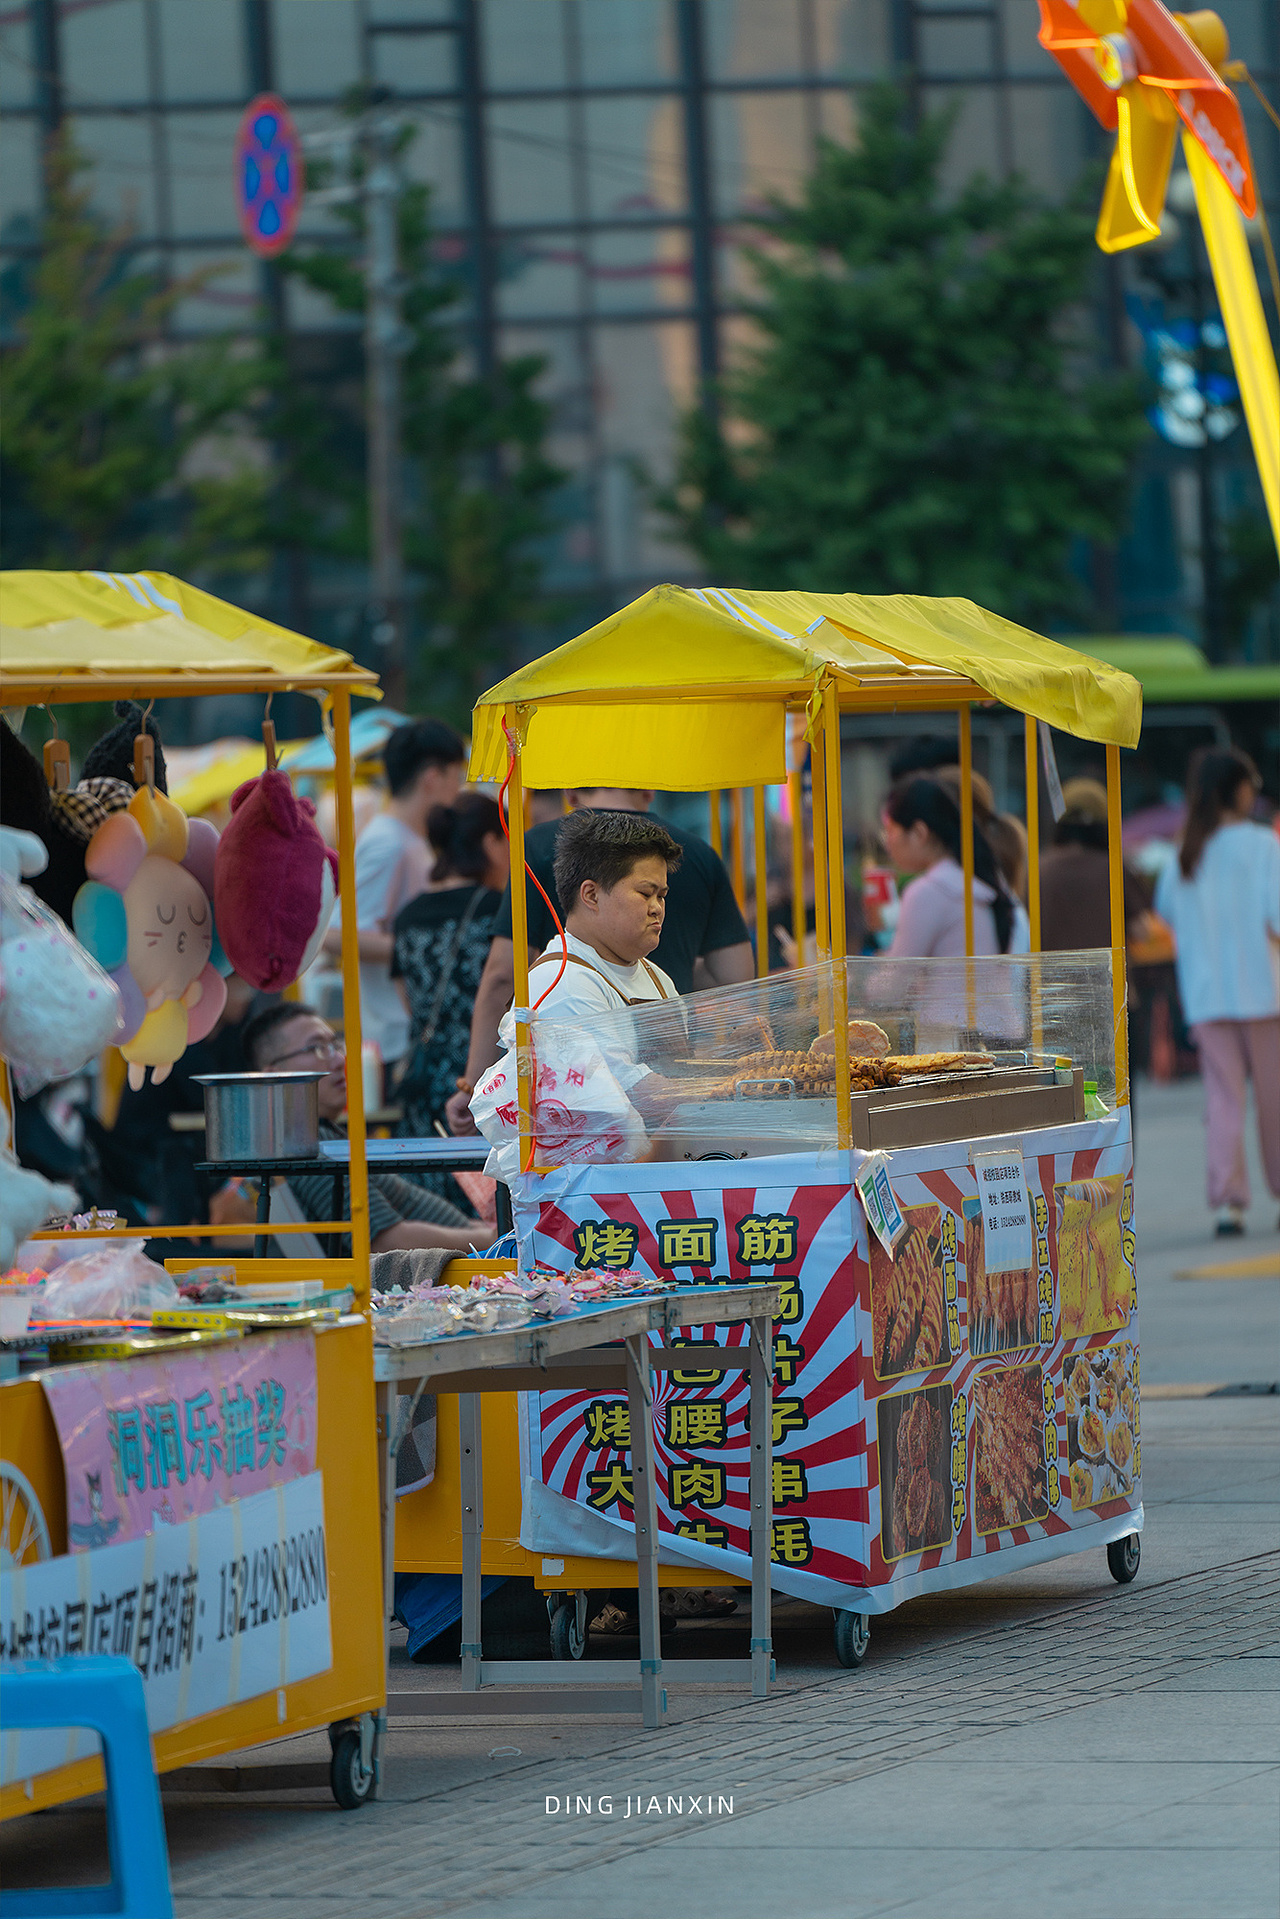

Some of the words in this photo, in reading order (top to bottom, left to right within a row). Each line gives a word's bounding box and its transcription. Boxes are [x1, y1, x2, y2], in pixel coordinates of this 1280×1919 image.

[576, 1217, 797, 1268] 烤面筋
[941, 1210, 963, 1353] 烤面筋
[1034, 1193, 1055, 1345] 手工烤肠
[106, 1376, 288, 1498] 洞洞乐抽奖
[588, 1401, 805, 1448] 烤腰子
[951, 1393, 967, 1532] 烤腰子
[1043, 1376, 1061, 1508] 大肉串
